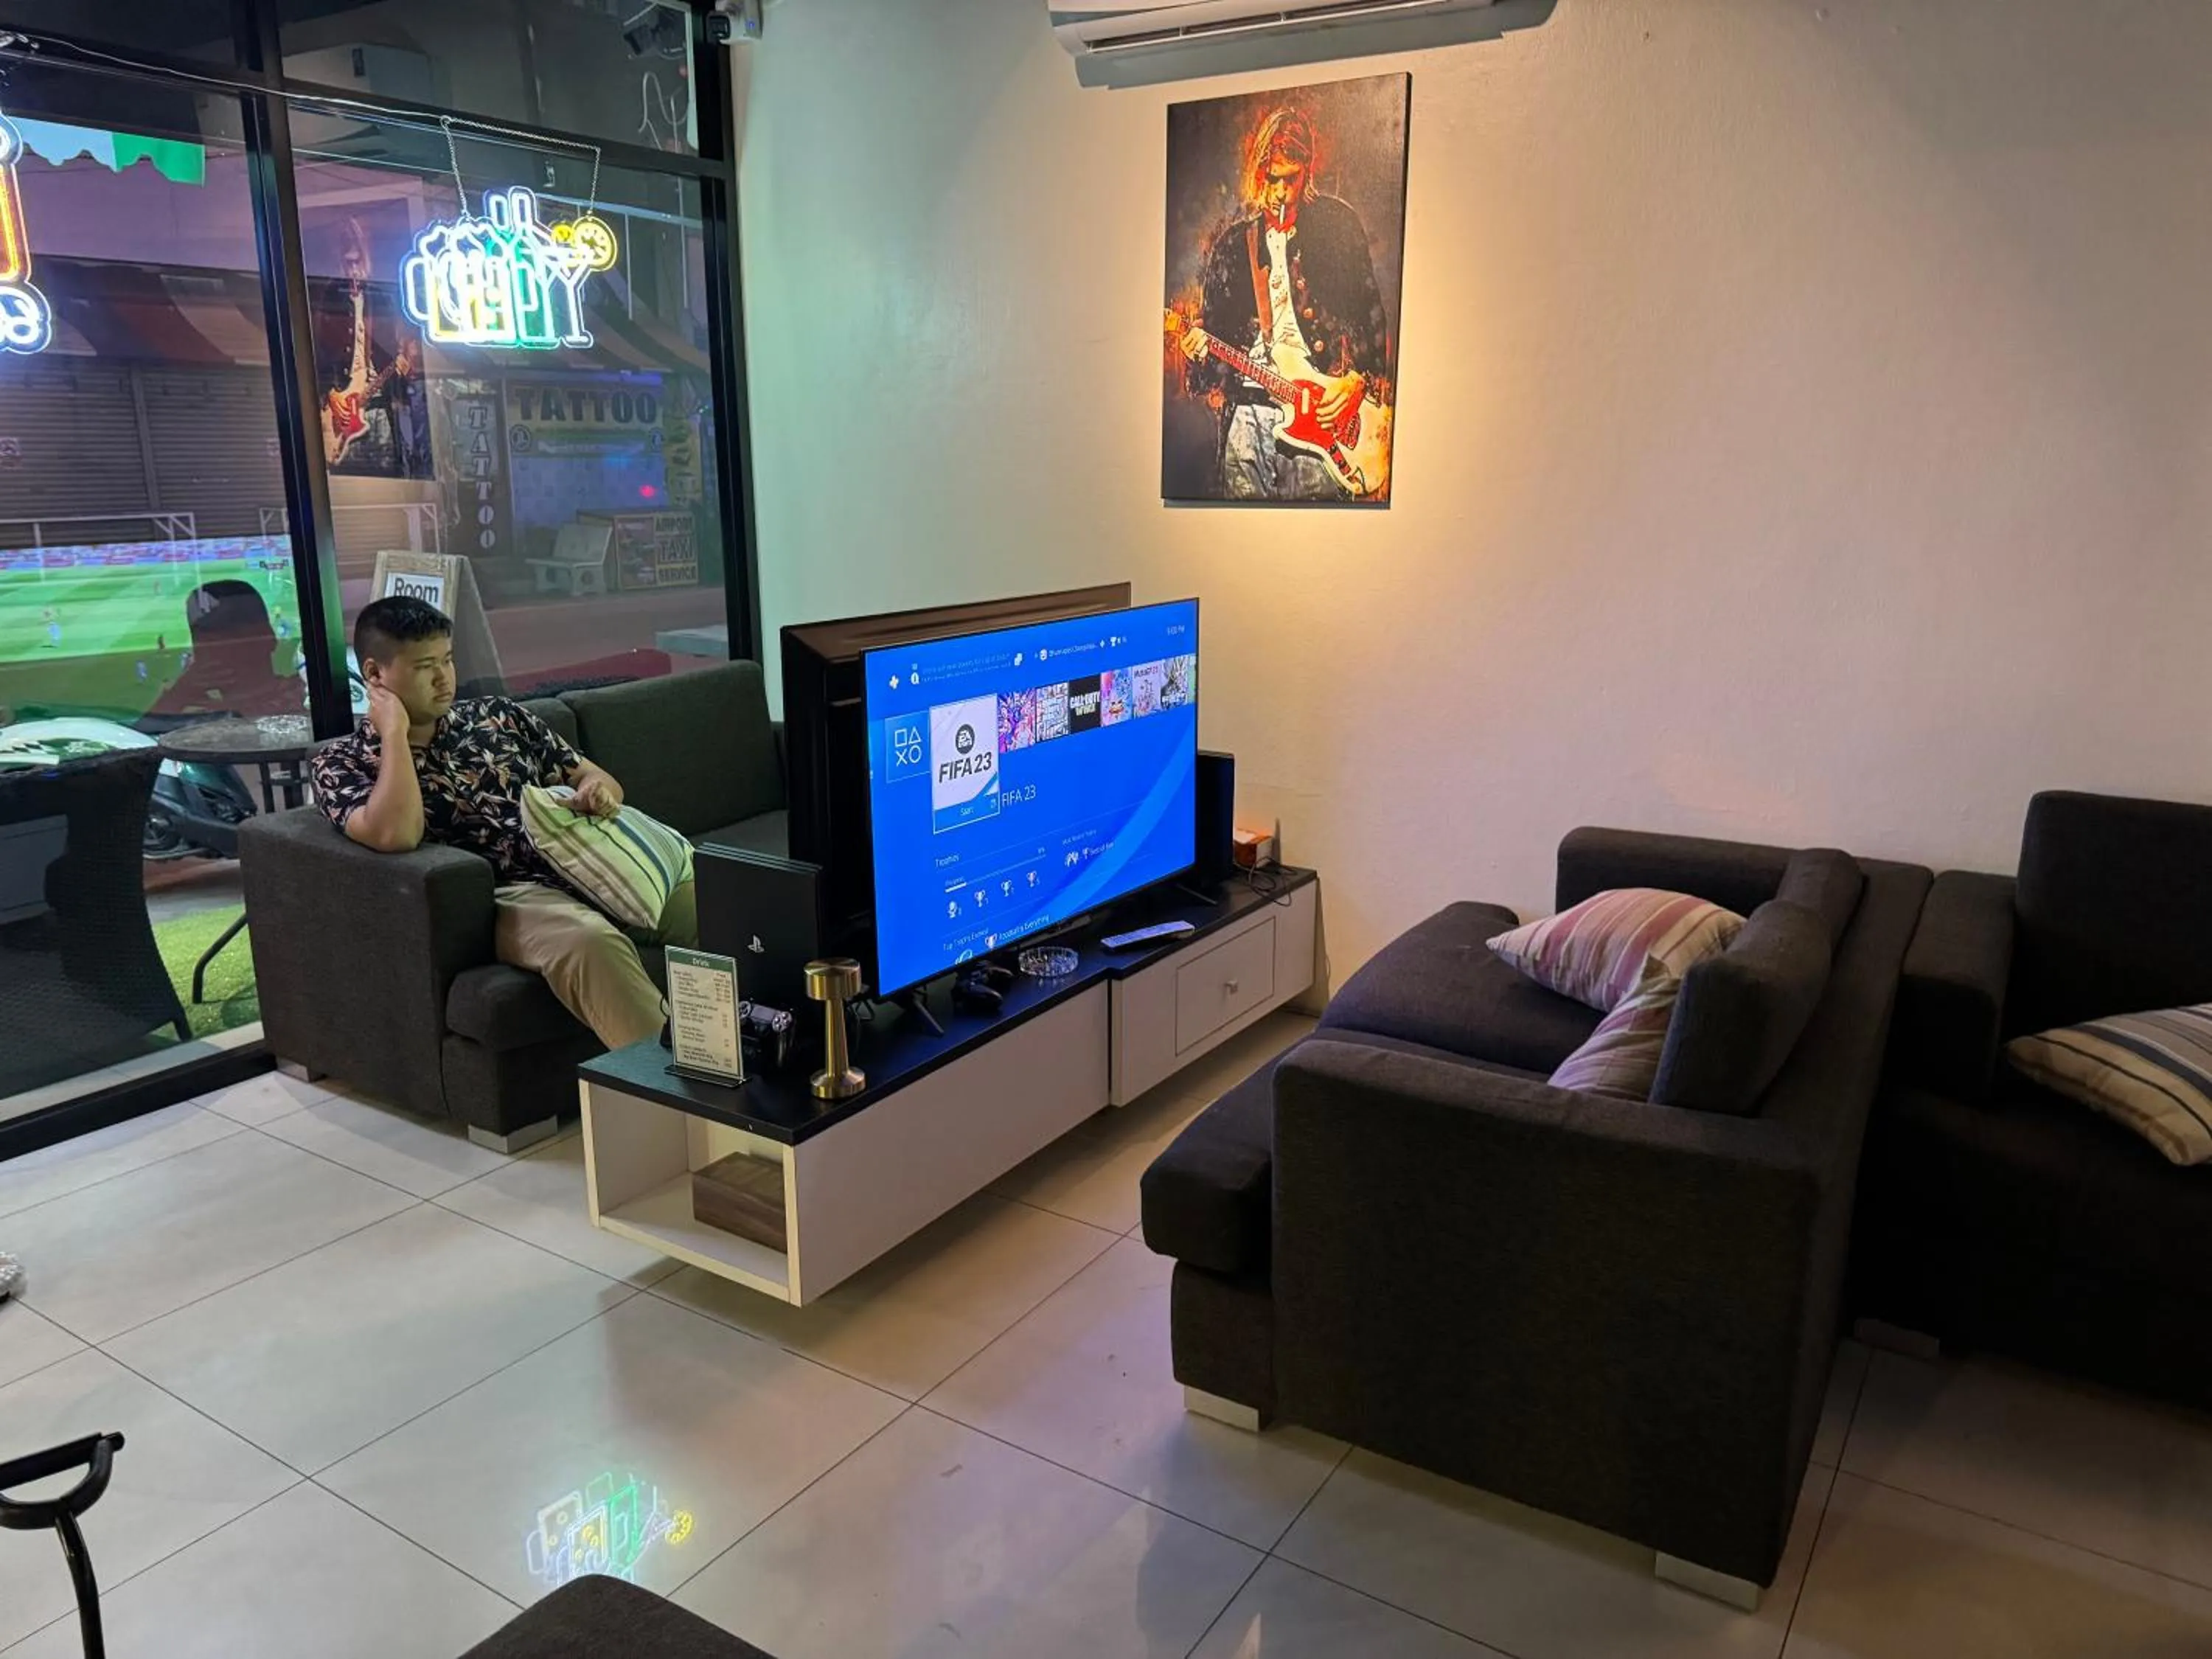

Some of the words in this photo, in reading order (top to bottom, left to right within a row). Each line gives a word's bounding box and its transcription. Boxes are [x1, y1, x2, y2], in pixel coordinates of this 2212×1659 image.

[515, 388, 657, 423] TATTOO
[468, 406, 495, 549] TATTOO
[658, 536, 694, 561] TAXI
[394, 578, 439, 602] Room
[939, 757, 973, 783] FIFA
[974, 751, 992, 773] 23
[1001, 789, 1023, 807] FIFA
[1024, 784, 1036, 800] 23
